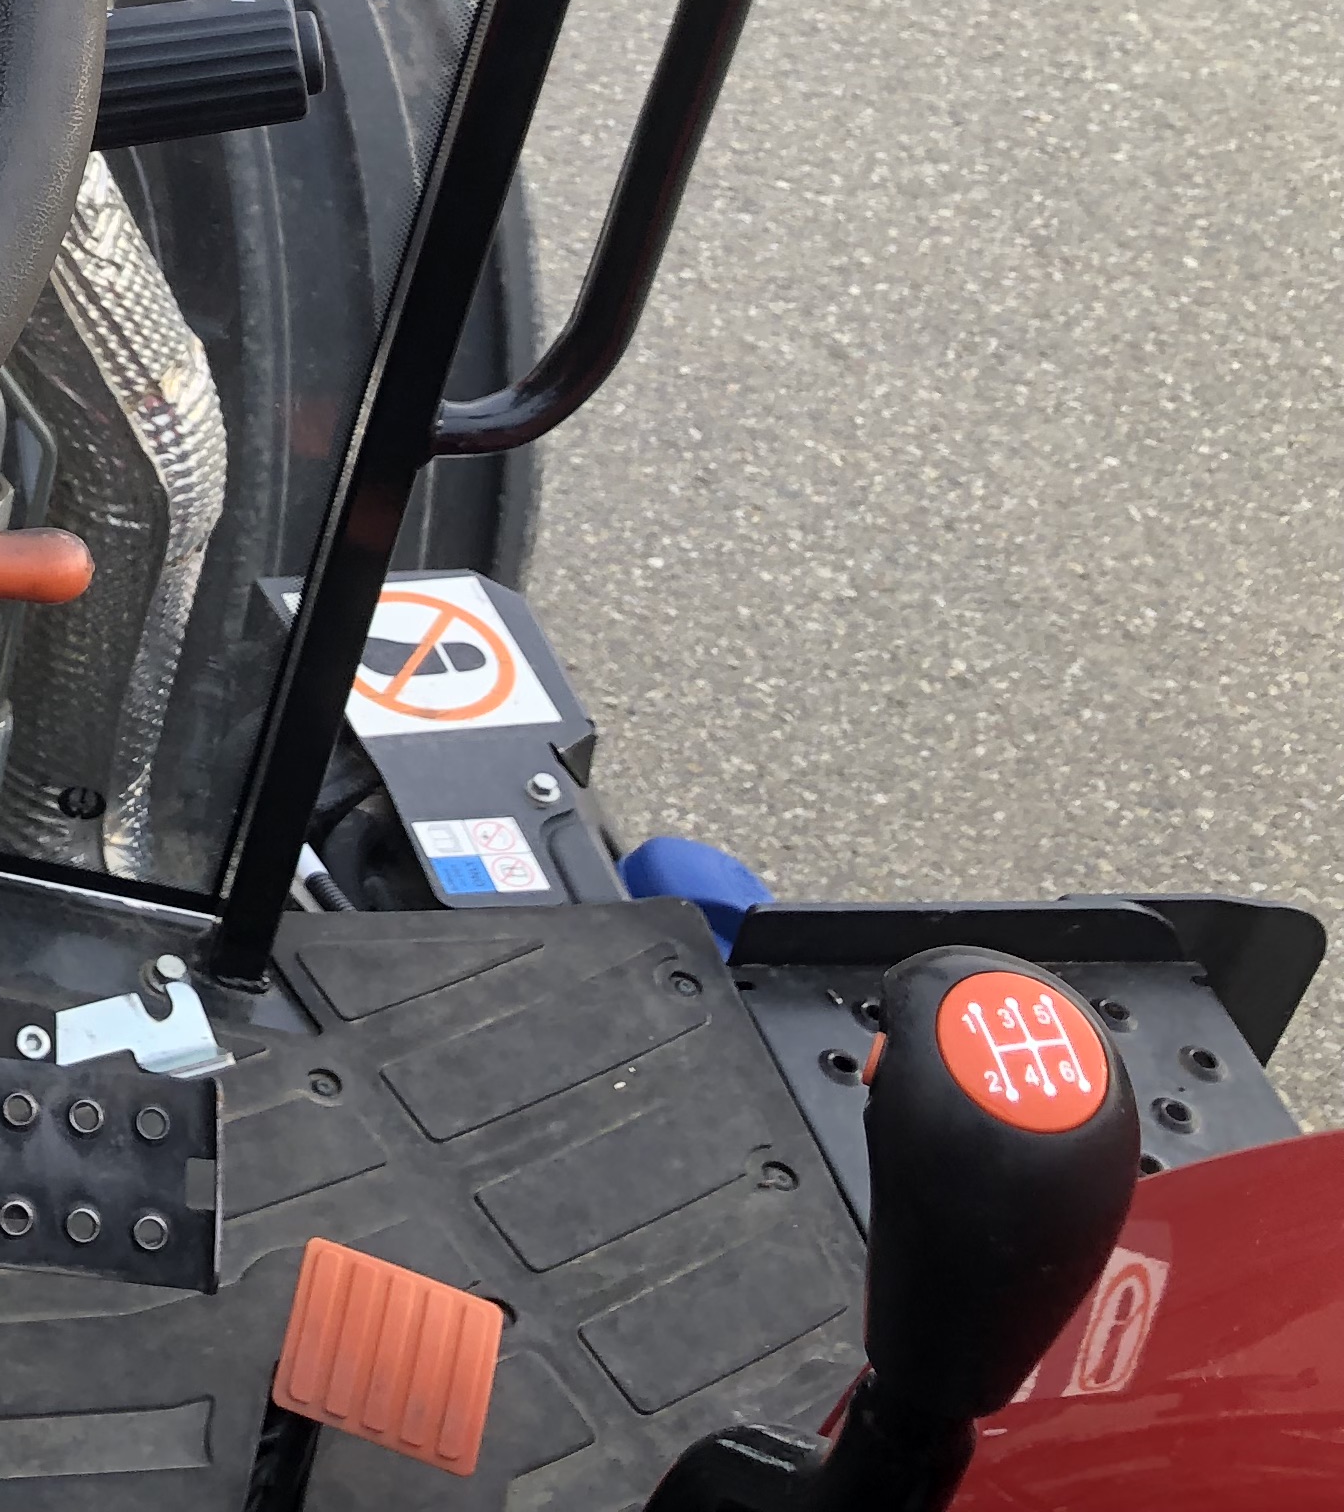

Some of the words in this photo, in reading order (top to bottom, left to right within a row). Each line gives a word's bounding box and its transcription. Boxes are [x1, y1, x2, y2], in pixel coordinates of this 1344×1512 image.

[961, 1013, 977, 1034] 1
[996, 1008, 1016, 1029] 3
[1032, 1004, 1051, 1025] 5
[983, 1070, 1003, 1093] 2
[1024, 1064, 1040, 1086] 4
[1058, 1060, 1075, 1083] 6
